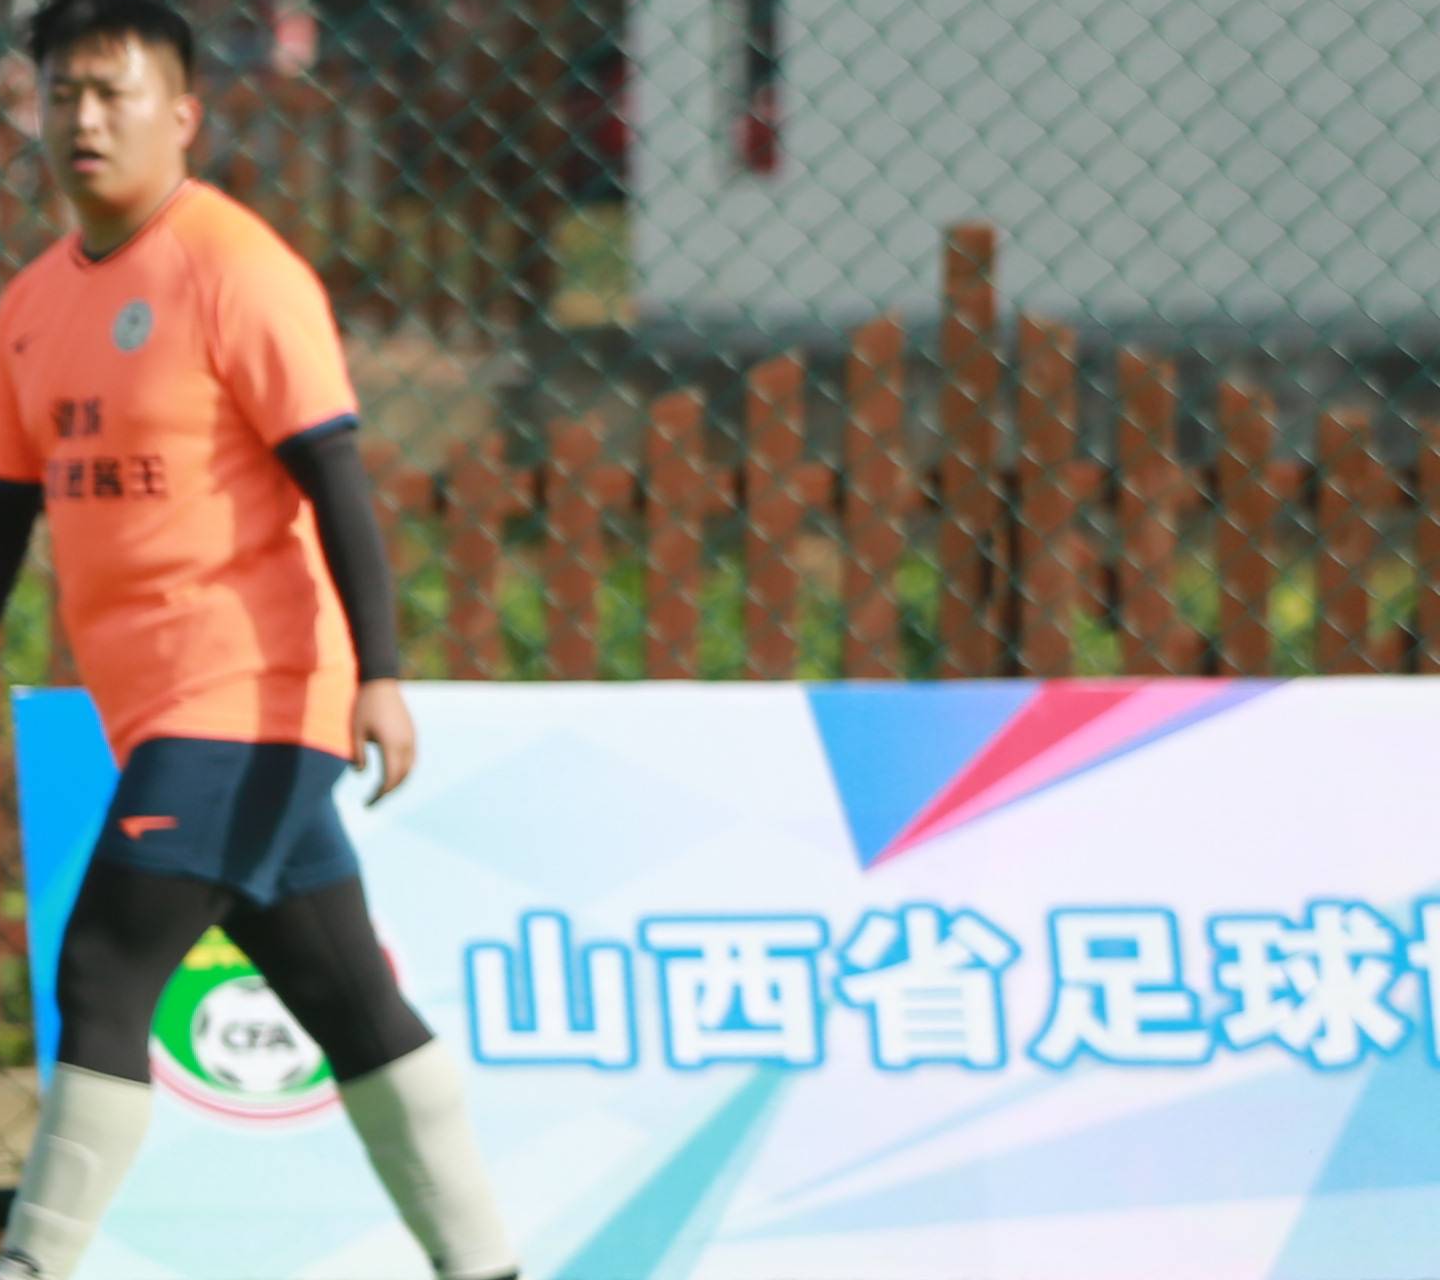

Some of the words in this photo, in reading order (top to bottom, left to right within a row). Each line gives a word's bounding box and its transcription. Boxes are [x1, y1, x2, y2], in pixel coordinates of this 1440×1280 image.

[467, 894, 1440, 1071] 山西省足球
